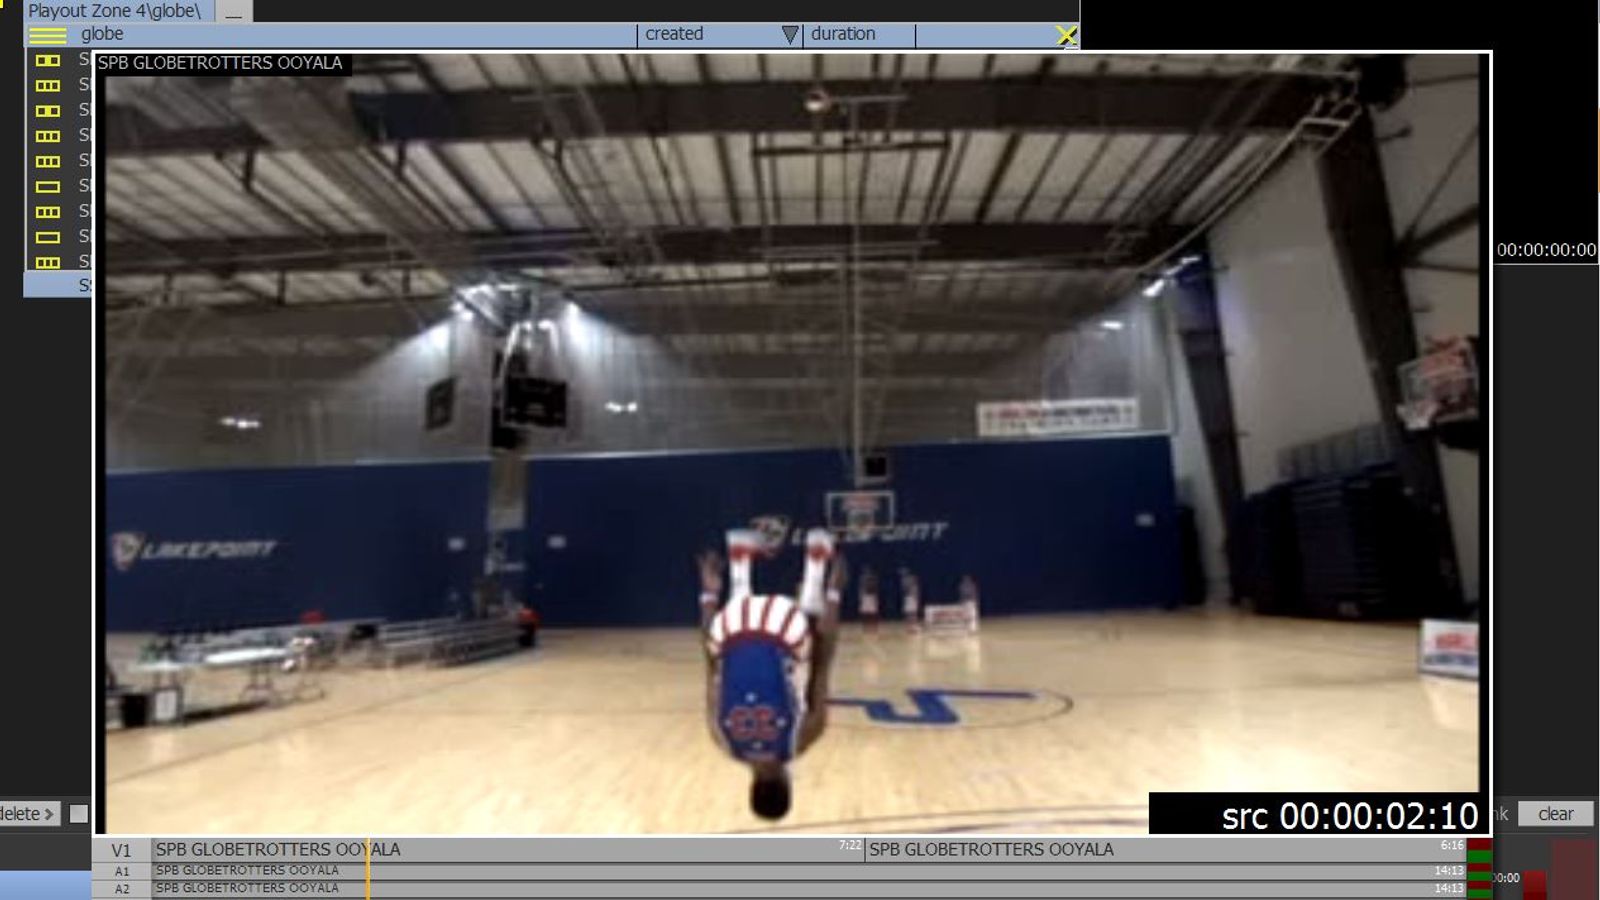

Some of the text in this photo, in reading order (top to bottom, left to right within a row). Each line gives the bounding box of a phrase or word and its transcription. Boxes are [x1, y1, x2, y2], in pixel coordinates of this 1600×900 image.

[29, 4, 88, 21] Playout
[92, 4, 131, 18] Zone
[81, 26, 124, 42] globe
[645, 26, 703, 41] created
[811, 26, 876, 41] duration
[98, 56, 343, 70] SPB GLOBETROTTERS OOYALA
[1497, 242, 1597, 257] 00:00:00:00
[1222, 801, 1480, 831] src 00:00:02:10
[1538, 806, 1575, 821] clear
[112, 844, 131, 858] V1
[156, 842, 401, 857] SPB GLOBETROTTERS OOYALA
[839, 839, 862, 850] 7:22
[869, 842, 1114, 857] SPB GLOBETROTTERS OOYALA
[1440, 839, 1465, 851] 6:16
[115, 867, 130, 877] A1
[156, 865, 339, 876] SPB GLOBETROTTERS OOYALA
[1434, 865, 1465, 876] 14:13
[115, 884, 130, 894] A2
[156, 882, 339, 893] SPB GLOBETROTTERS OOYALA
[1434, 882, 1465, 893] 14:13
